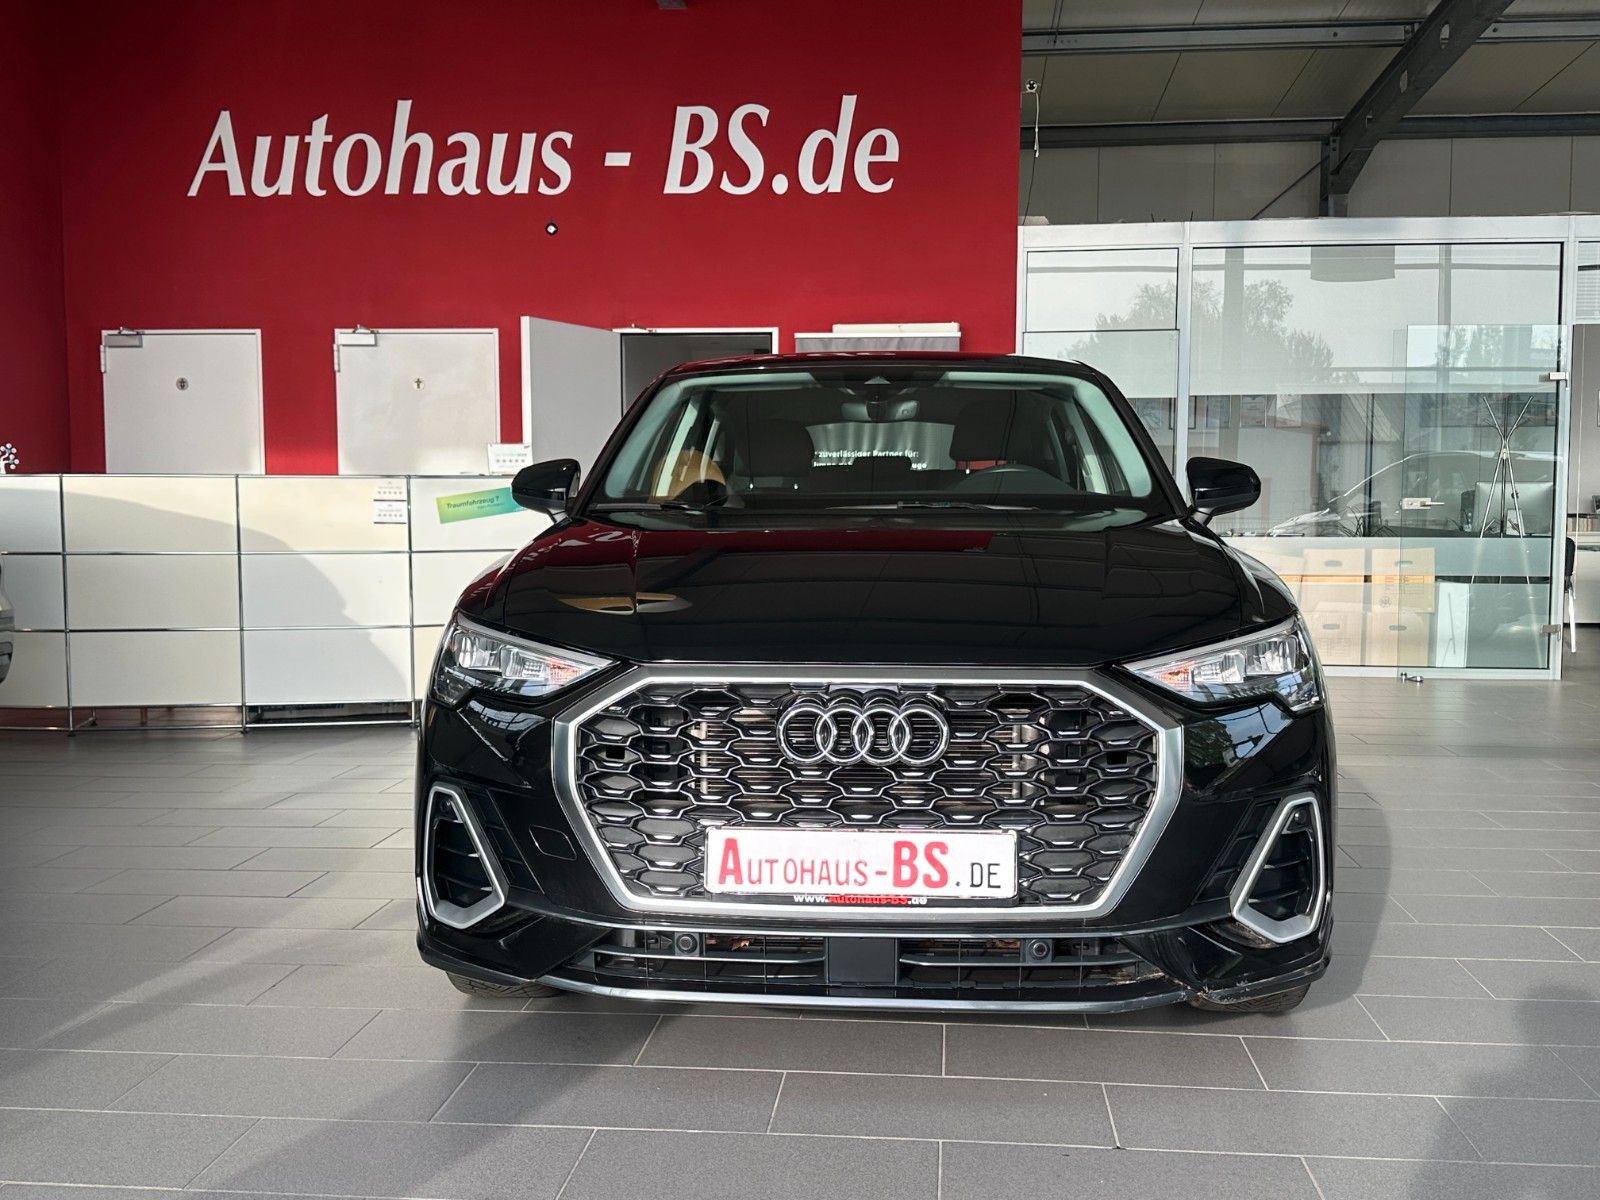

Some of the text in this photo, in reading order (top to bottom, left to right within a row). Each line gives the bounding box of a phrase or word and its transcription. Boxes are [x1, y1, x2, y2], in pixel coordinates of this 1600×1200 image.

[186, 94, 900, 198] Autohaus - BS.de
[872, 449, 902, 458] Partner
